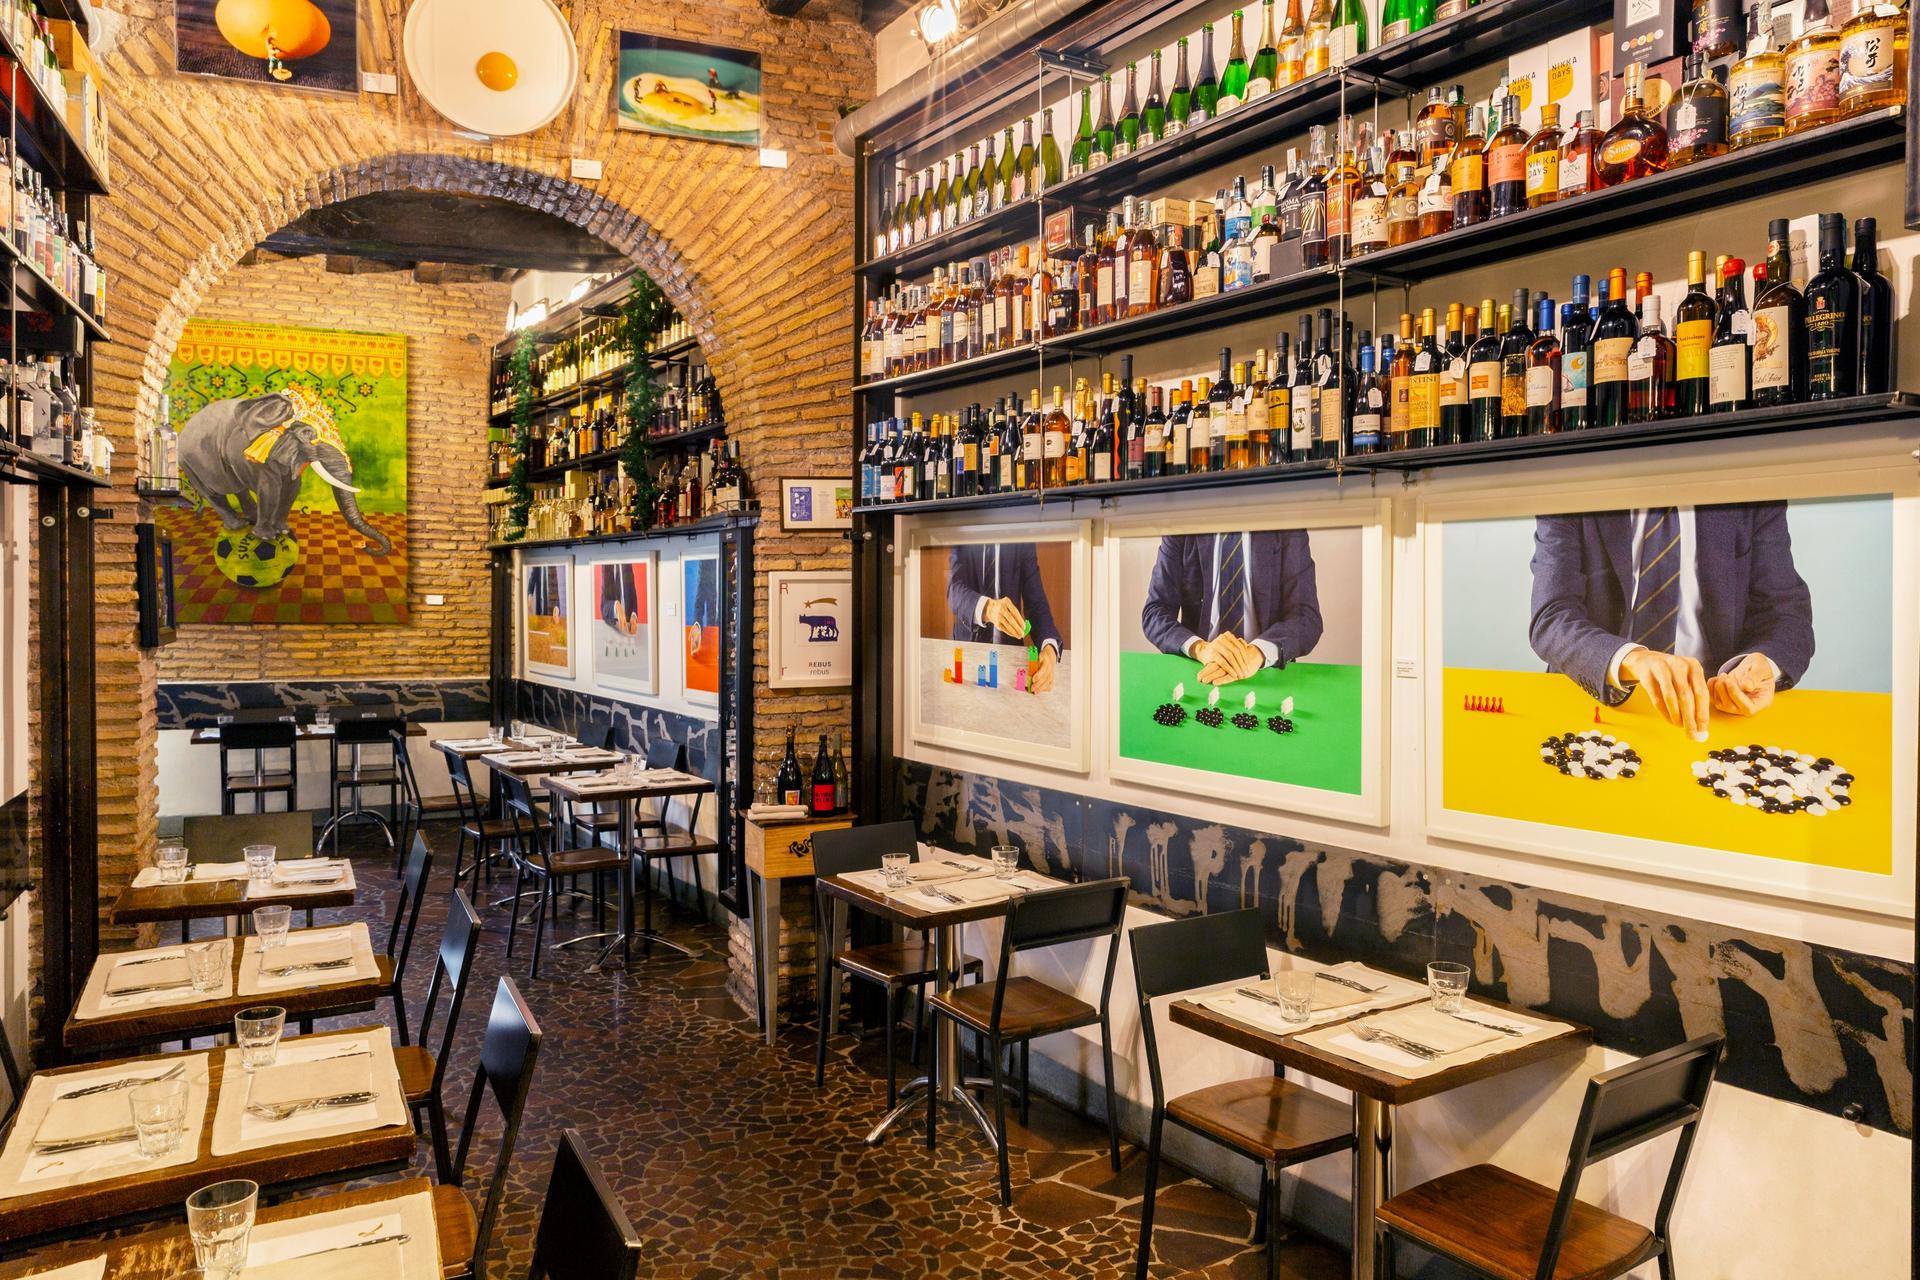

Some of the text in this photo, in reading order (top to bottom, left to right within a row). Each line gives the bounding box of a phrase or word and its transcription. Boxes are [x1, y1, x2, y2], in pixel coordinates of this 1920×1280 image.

[1551, 56, 1578, 71] NIKKA
[1512, 72, 1536, 85] NIKKA
[1551, 67, 1572, 80] DAYS
[1512, 82, 1531, 94] DAYS
[1528, 154, 1557, 168] NIKKA
[1528, 166, 1549, 179] DAYS
[779, 582, 789, 594] R
[808, 661, 832, 669] REBUS
[809, 668, 830, 676] rebus
